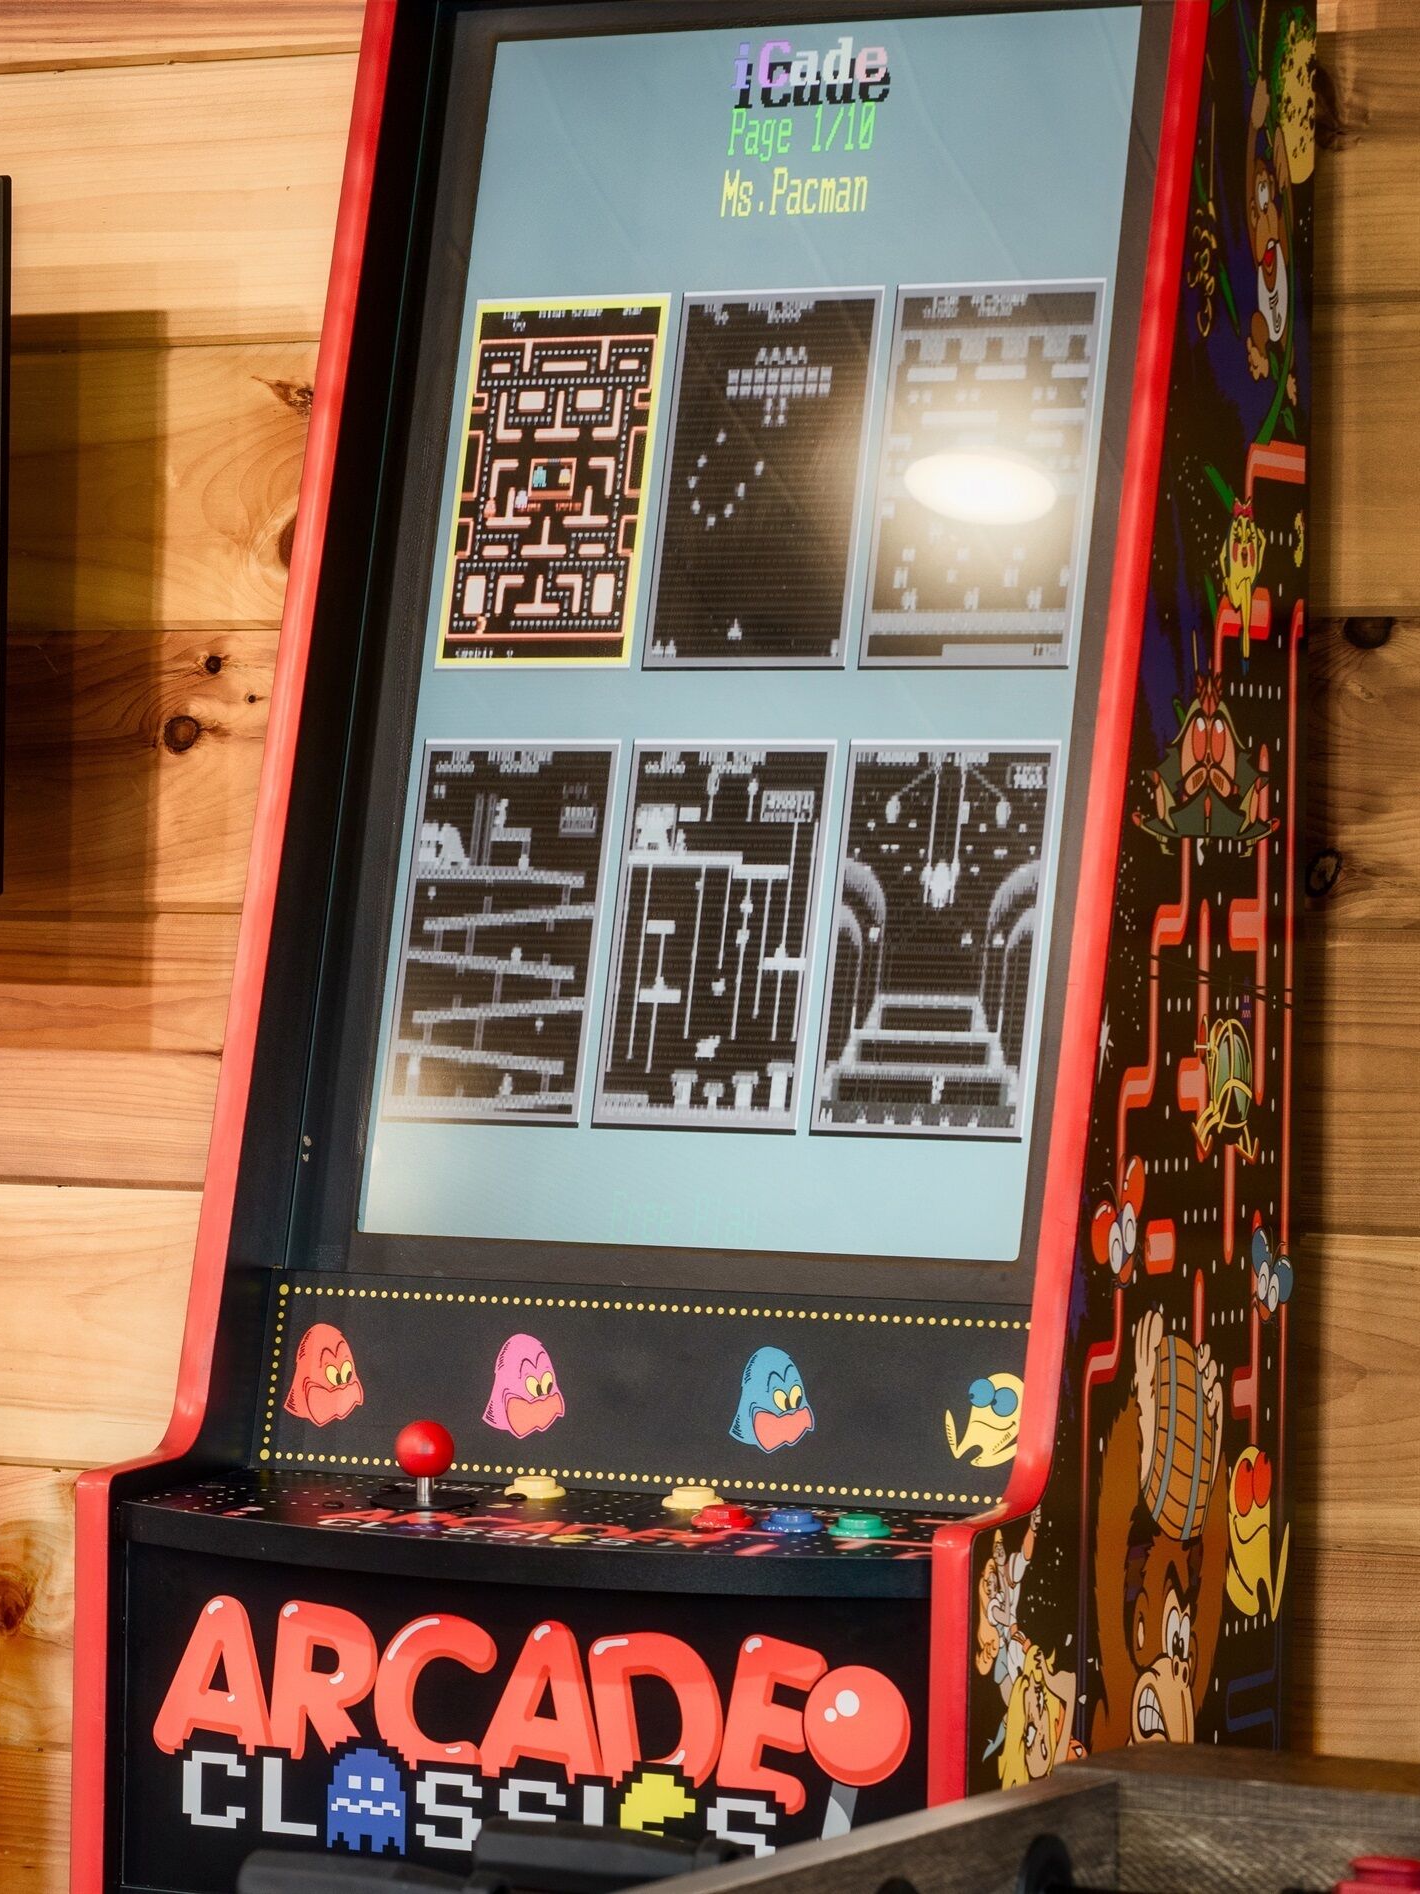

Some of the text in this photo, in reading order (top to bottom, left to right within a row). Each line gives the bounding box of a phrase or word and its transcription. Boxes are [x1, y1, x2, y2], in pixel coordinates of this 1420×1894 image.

[731, 37, 890, 108] iCade
[728, 101, 876, 162] Page 1/10
[720, 167, 868, 217] Ms.Pacman
[153, 1596, 829, 1815] ARCADE
